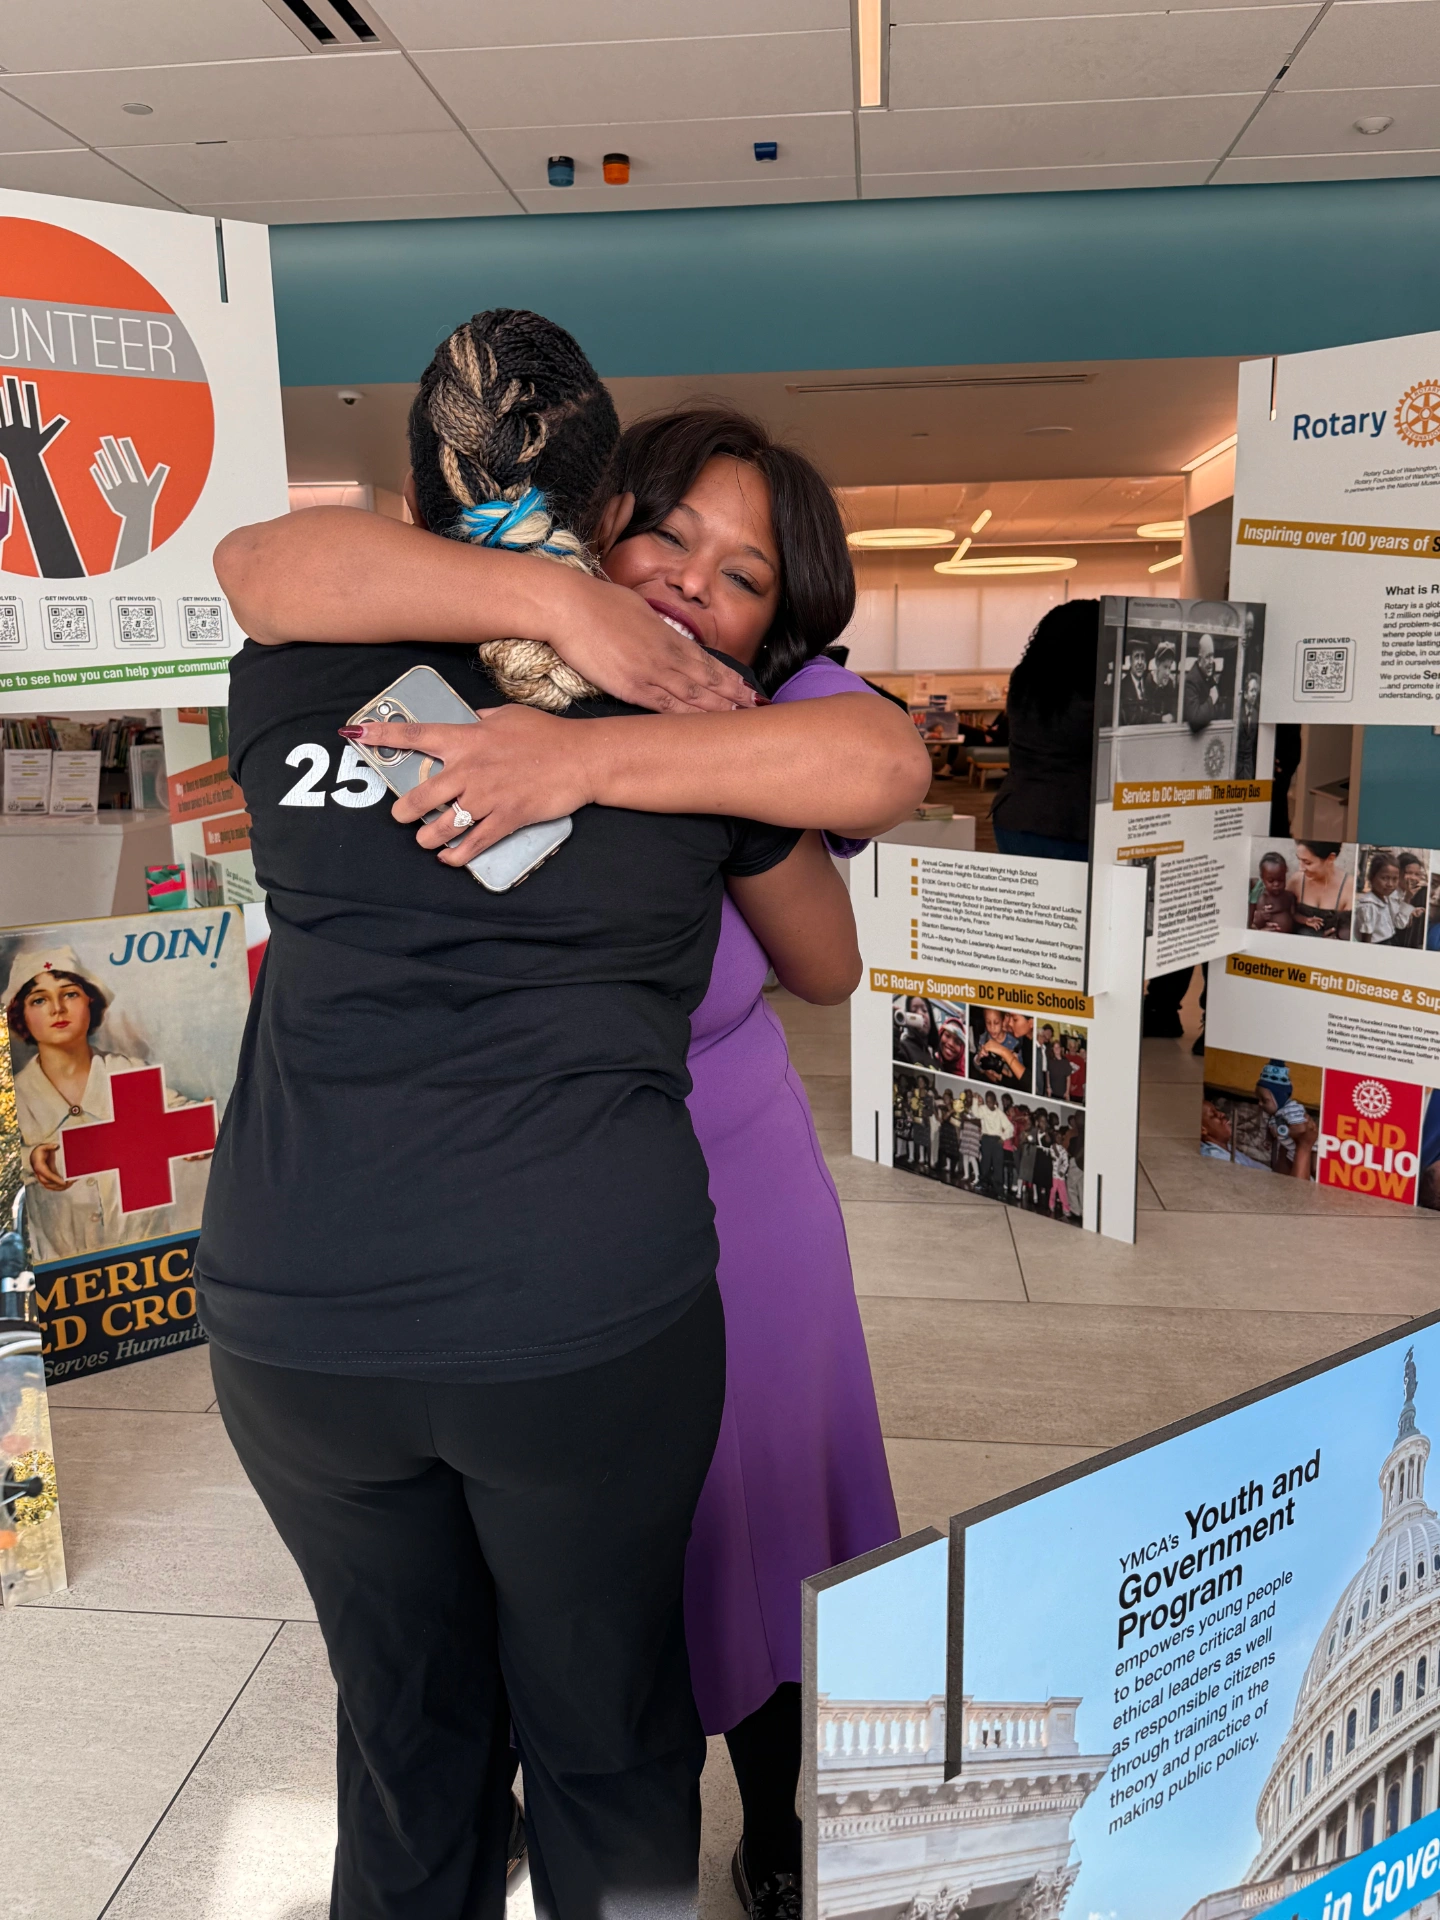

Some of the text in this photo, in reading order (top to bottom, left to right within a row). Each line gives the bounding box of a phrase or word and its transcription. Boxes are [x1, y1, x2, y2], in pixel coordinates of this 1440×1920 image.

[1293, 410, 1387, 441] Rotary
[1372, 476, 1404, 484] Foundation
[1382, 468, 1395, 476] Club
[1396, 481, 1420, 489] National
[1244, 524, 1302, 546] Inspiring
[1305, 530, 1337, 546] over
[1341, 530, 1367, 547] 100
[1368, 534, 1410, 552] years
[1413, 536, 1431, 552] of
[1384, 602, 1408, 610] Rotary
[1386, 586, 1415, 596] What
[1418, 584, 1428, 594] is
[1406, 630, 1432, 638] people
[1394, 650, 1418, 658] globe,
[16, 675, 28, 686] to
[30, 674, 50, 685] see
[53, 672, 78, 684] how
[80, 671, 100, 683] you
[103, 668, 123, 679] can
[126, 666, 150, 678] help
[151, 664, 176, 678] your
[1394, 672, 1422, 680] provide
[278, 742, 388, 808] 25
[1122, 784, 1260, 804] Service to DC began with The Rotary Bus
[970, 864, 988, 872] Richard
[1006, 868, 1018, 876] High
[109, 911, 231, 969] JOIN!
[874, 972, 1086, 1011] DC Rotary Supports DC Public Schools
[981, 964, 1002, 972] program
[1019, 970, 1034, 978] Public
[1036, 974, 1053, 982] School
[1231, 957, 1284, 981] Together
[1288, 968, 1306, 983] We
[1309, 971, 1344, 992] Fight
[1346, 978, 1399, 1001] Disease
[1402, 988, 1413, 1004] &
[1336, 1114, 1407, 1150] END
[1318, 1133, 1419, 1178] POLIO
[1328, 1159, 1409, 1199] NOW
[35, 1248, 196, 1313] MERIC
[44, 1350, 110, 1379] Serves
[1119, 1448, 1320, 1574] YMCA's Youth and
[1119, 1497, 1295, 1610] Government
[1115, 1570, 1293, 1677] empowers young people
[1118, 1565, 1243, 1650] Program
[1115, 1600, 1275, 1703] to become critical and
[1113, 1626, 1273, 1730] ethical leaders as well
[1111, 1652, 1276, 1757] as responsible citizens
[1111, 1679, 1269, 1783] through training in the
[1110, 1699, 1269, 1809] theory and practice of
[1109, 1733, 1260, 1836] making public policy.
[1362, 1838, 1440, 1917] Gove
